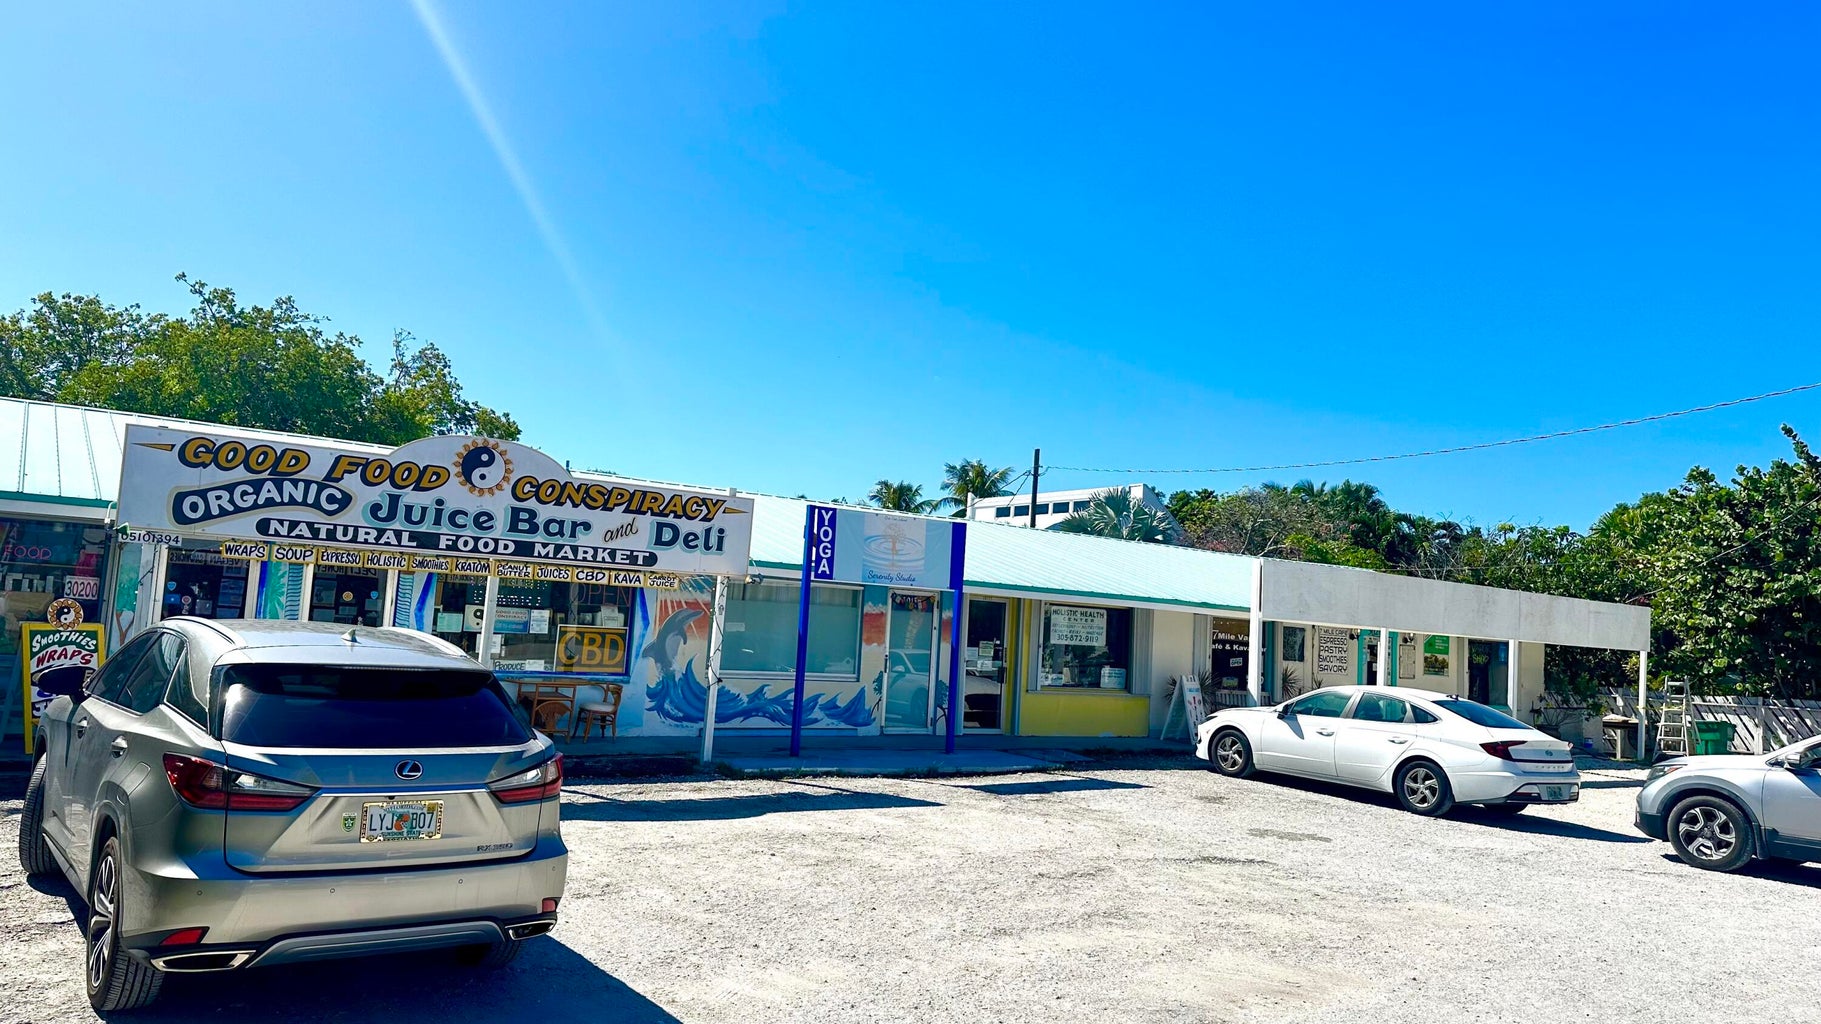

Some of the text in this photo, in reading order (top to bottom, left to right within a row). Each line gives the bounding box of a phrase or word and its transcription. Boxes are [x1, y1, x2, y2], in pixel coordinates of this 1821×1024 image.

[178, 437, 725, 521] GOOD FOOD CONSPIRACY
[182, 480, 342, 519] ORGANIC
[369, 492, 726, 552] Juice Bar and Deli
[268, 519, 650, 565] NATURAL FOOD MARKET
[818, 509, 833, 575] YOGA
[224, 543, 266, 558] WRAPS
[274, 547, 314, 561] SOUP
[320, 551, 361, 566] EXPRESSO
[366, 554, 407, 568] HOLISTIC
[411, 558, 449, 571] SMOOTHIES
[454, 560, 491, 573] KRATOM
[497, 563, 530, 571] PEANUT
[497, 569, 531, 578] BUTTER
[536, 567, 570, 580] JUICES
[576, 570, 605, 582] CBD
[613, 573, 641, 585] KAVA
[867, 569, 894, 582] Serenity
[65, 580, 98, 598] 30200
[649, 580, 676, 588] JUICE
[1052, 609, 1104, 619] HOLISTIC HEALTH
[1320, 636, 1347, 646] ESPRESSO
[557, 630, 625, 666] CBD
[1320, 646, 1347, 655] PASTRY
[36, 647, 94, 668] WRAPS
[495, 661, 526, 671] PRODUCE
[1319, 664, 1348, 673] SAVORY
[369, 813, 395, 831] LYJ
